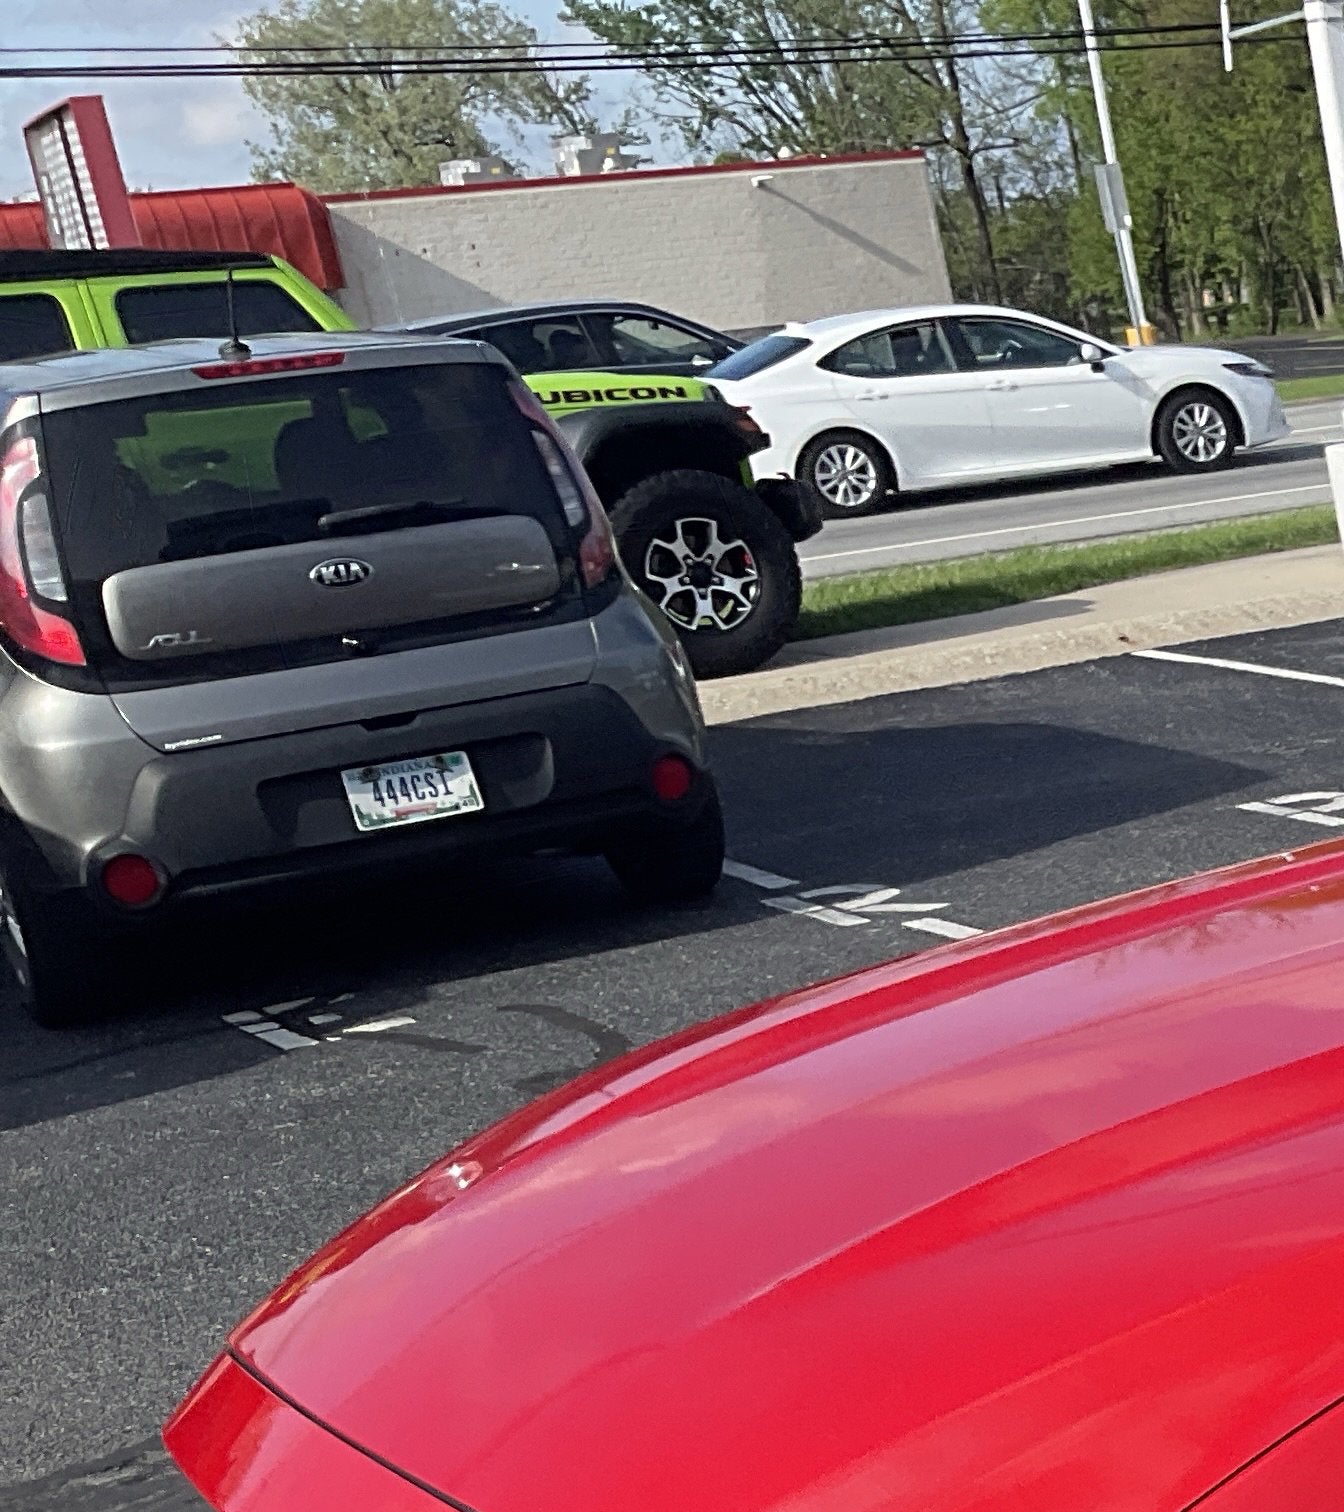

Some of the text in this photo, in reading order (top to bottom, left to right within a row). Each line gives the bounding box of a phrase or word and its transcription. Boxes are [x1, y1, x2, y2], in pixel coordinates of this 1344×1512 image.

[533, 386, 688, 404] UBICON
[320, 562, 365, 585] KIA
[760, 883, 950, 926] R
